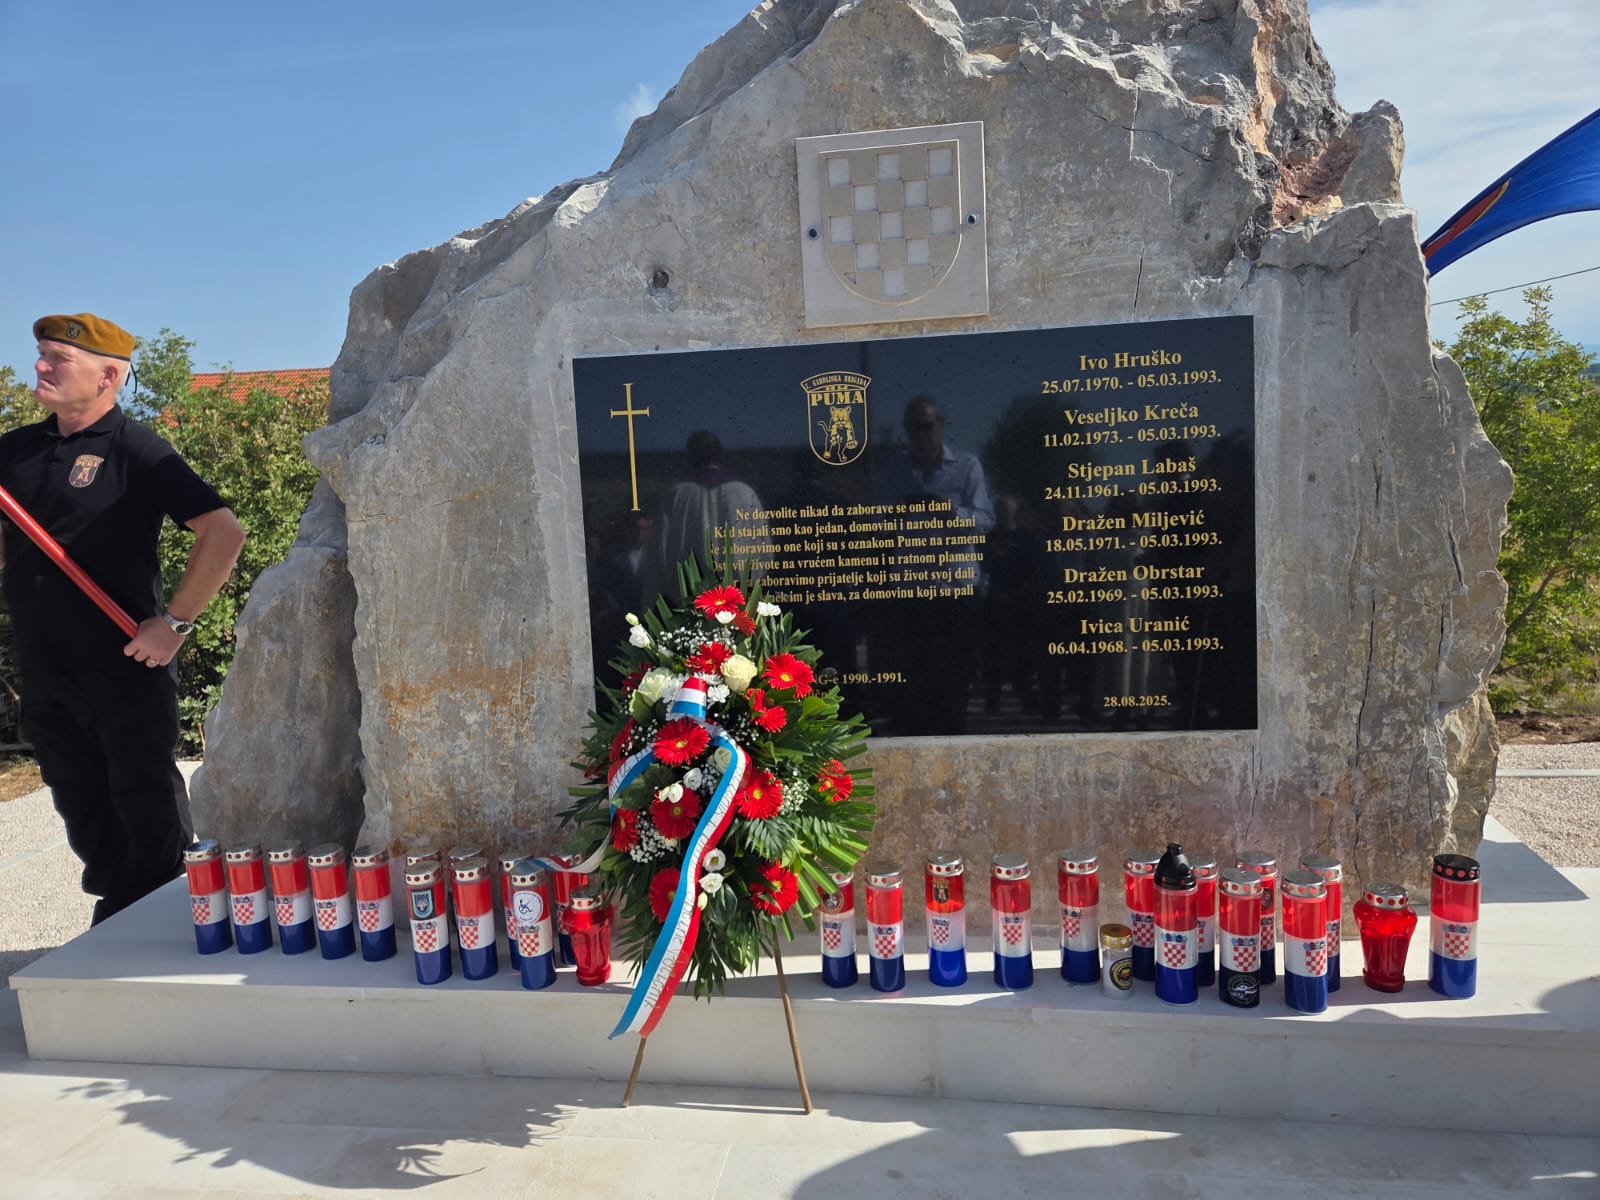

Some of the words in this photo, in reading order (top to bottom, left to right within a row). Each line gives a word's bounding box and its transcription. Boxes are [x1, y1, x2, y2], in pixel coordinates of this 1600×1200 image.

[1079, 355, 1108, 371] Ivo
[1114, 350, 1182, 368] Hruško
[1041, 376, 1123, 394] 25.07.1970.
[1137, 370, 1222, 388] 05.03.1993.
[810, 391, 864, 406] PUMA
[1064, 407, 1138, 427] Veseljko
[1144, 402, 1199, 421] Kreča
[1043, 430, 1123, 448] 11.02.1973.
[1137, 425, 1221, 442] 05.03.1993.
[1068, 462, 1135, 481] Stjepan
[1141, 456, 1196, 475] Labaš
[1044, 483, 1125, 500] 24.11.1961.
[1138, 478, 1222, 495] 05.03.1993.
[735, 509, 750, 520] Ne
[752, 506, 797, 520] dozvolite
[800, 505, 829, 518] nikad
[831, 505, 844, 516] da
[846, 504, 894, 516] zaborave
[896, 504, 907, 513] se
[909, 500, 925, 512] oni
[928, 499, 952, 512] dani
[738, 525, 768, 540] stajali
[770, 526, 792, 536] smo
[794, 523, 813, 535] kao
[814, 522, 847, 537] jedan,
[849, 519, 897, 533] domovini
[900, 518, 904, 531] i
[906, 517, 944, 530] narodu
[946, 515, 976, 528] odani
[1062, 514, 1125, 532] Dražen
[1132, 509, 1205, 531] Miljević
[711, 543, 720, 555] e
[722, 542, 781, 555] zboravimo
[783, 543, 802, 553] one
[804, 540, 824, 554] koji
[826, 542, 838, 551] su
[840, 541, 846, 550] s
[848, 537, 895, 550] oznakom
[897, 535, 927, 548] Pume
[930, 537, 943, 546] na
[945, 534, 986, 545] ramenu
[1046, 537, 1125, 552] 18.05.1971.
[1140, 532, 1223, 548] 05.03.1993.
[782, 560, 795, 569] na
[797, 556, 835, 569] vrućem
[838, 555, 879, 567] kamenu
[881, 553, 885, 565] i
[888, 556, 895, 565] u
[897, 553, 936, 564] ratnom
[938, 551, 984, 566] plamenu
[761, 574, 815, 588] aboravimo
[817, 571, 864, 587] prijatelje
[866, 570, 887, 586] koji
[889, 572, 901, 582] su
[904, 569, 928, 581] život
[931, 567, 952, 583] svoj
[954, 566, 975, 579] dali
[1064, 567, 1128, 584] Dražen
[1132, 564, 1205, 581] Obrstar
[789, 591, 803, 603] im
[805, 590, 816, 605] je
[817, 589, 847, 603] slava,
[848, 590, 860, 601] za
[862, 586, 914, 600] domovinu
[916, 585, 937, 600] koji
[939, 587, 951, 596] su
[954, 584, 974, 599] pali
[1047, 589, 1127, 604] 25.02.1969.
[1141, 585, 1223, 600] 05.03.1993.
[1080, 618, 1123, 635] Ivica
[1129, 616, 1190, 633] Uranić
[1048, 641, 1128, 655] 06.04.1968.
[1142, 637, 1224, 652] 05.03.1993.
[842, 672, 907, 684] 1990.-1991.
[1104, 695, 1171, 707] 28.08.2025.
